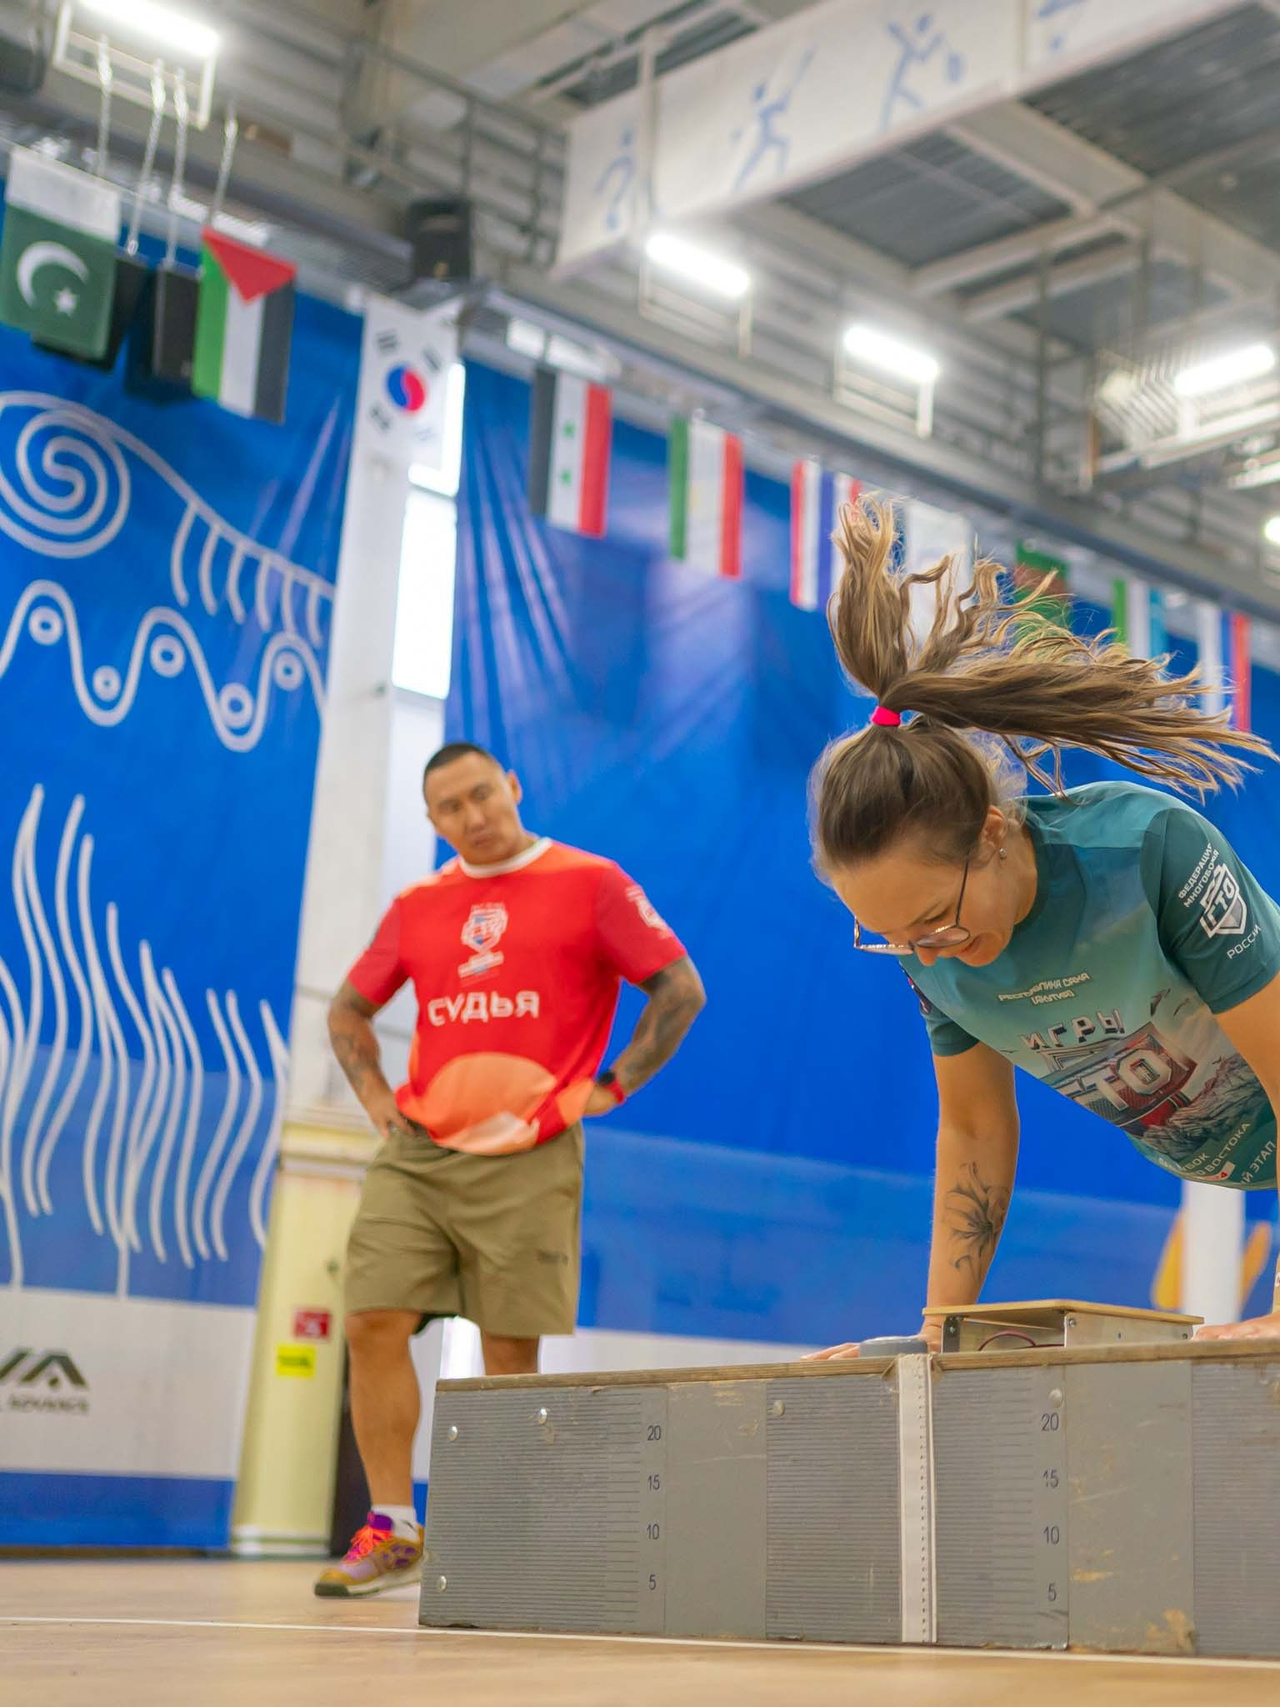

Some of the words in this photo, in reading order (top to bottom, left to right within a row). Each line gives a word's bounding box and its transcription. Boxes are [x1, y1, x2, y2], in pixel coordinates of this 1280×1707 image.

[1183, 849, 1219, 908] МНОГОБОЯ
[1206, 877, 1236, 927] ГТО
[428, 990, 540, 1027] СУДЬЯ
[1020, 1009, 1125, 1050] ИГРЫ
[1205, 1123, 1251, 1173] ВОСТОКА
[1250, 1140, 1277, 1172] ЭТАП
[1181, 1153, 1211, 1172] УБОК
[1041, 1412, 1060, 1432] 20
[647, 1425, 662, 1441] 20
[647, 1474, 661, 1491] 15
[1042, 1469, 1060, 1489] 15
[646, 1523, 660, 1540] 10
[1043, 1525, 1060, 1545] 10
[649, 1574, 657, 1590] 5
[1048, 1582, 1057, 1602] 5
